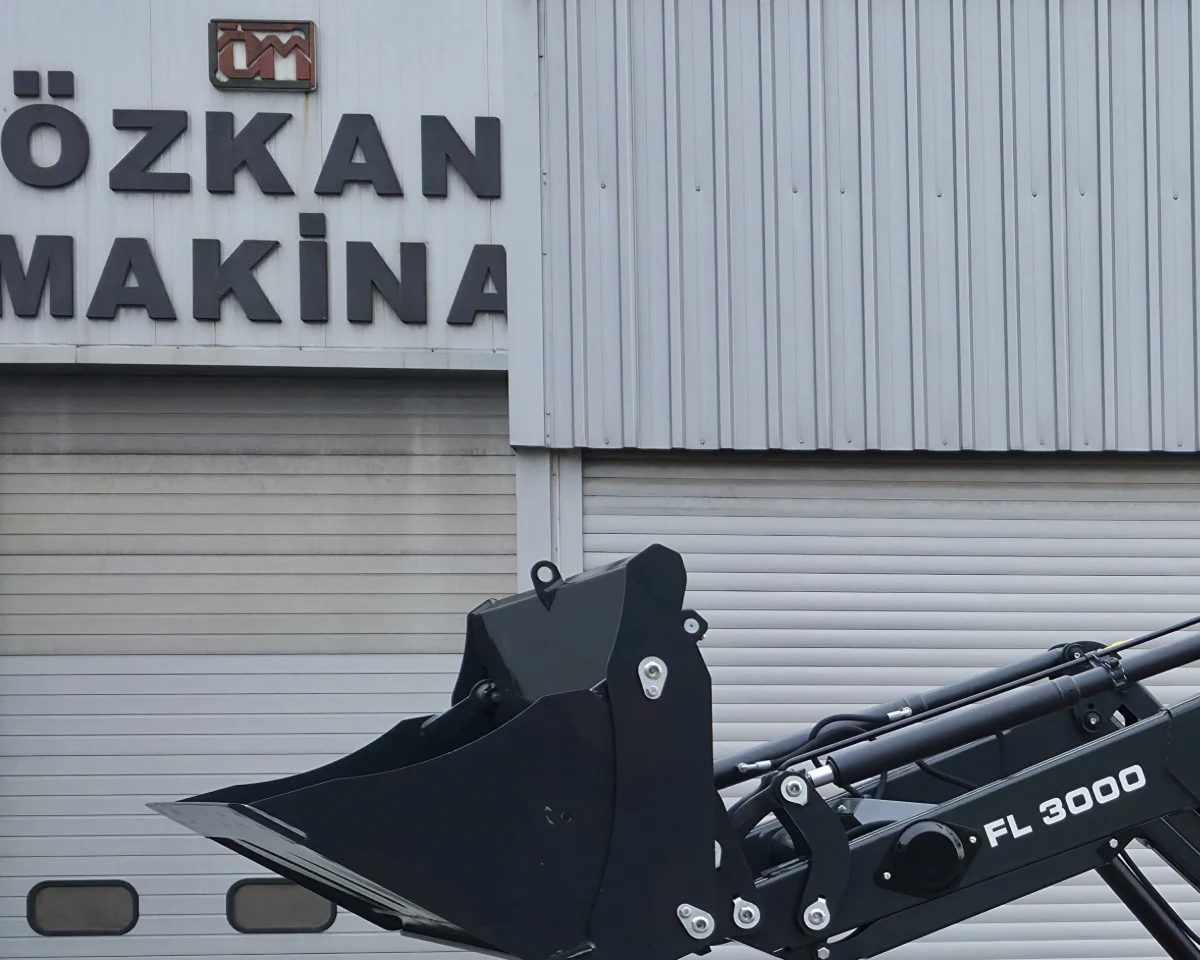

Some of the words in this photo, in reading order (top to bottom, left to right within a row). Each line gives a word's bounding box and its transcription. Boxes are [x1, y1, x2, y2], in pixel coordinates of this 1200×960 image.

[0, 70, 501, 199] ÖZKAN
[0, 212, 507, 326] MAKİNA
[983, 814, 1033, 848] FL
[1038, 764, 1147, 826] 3000
